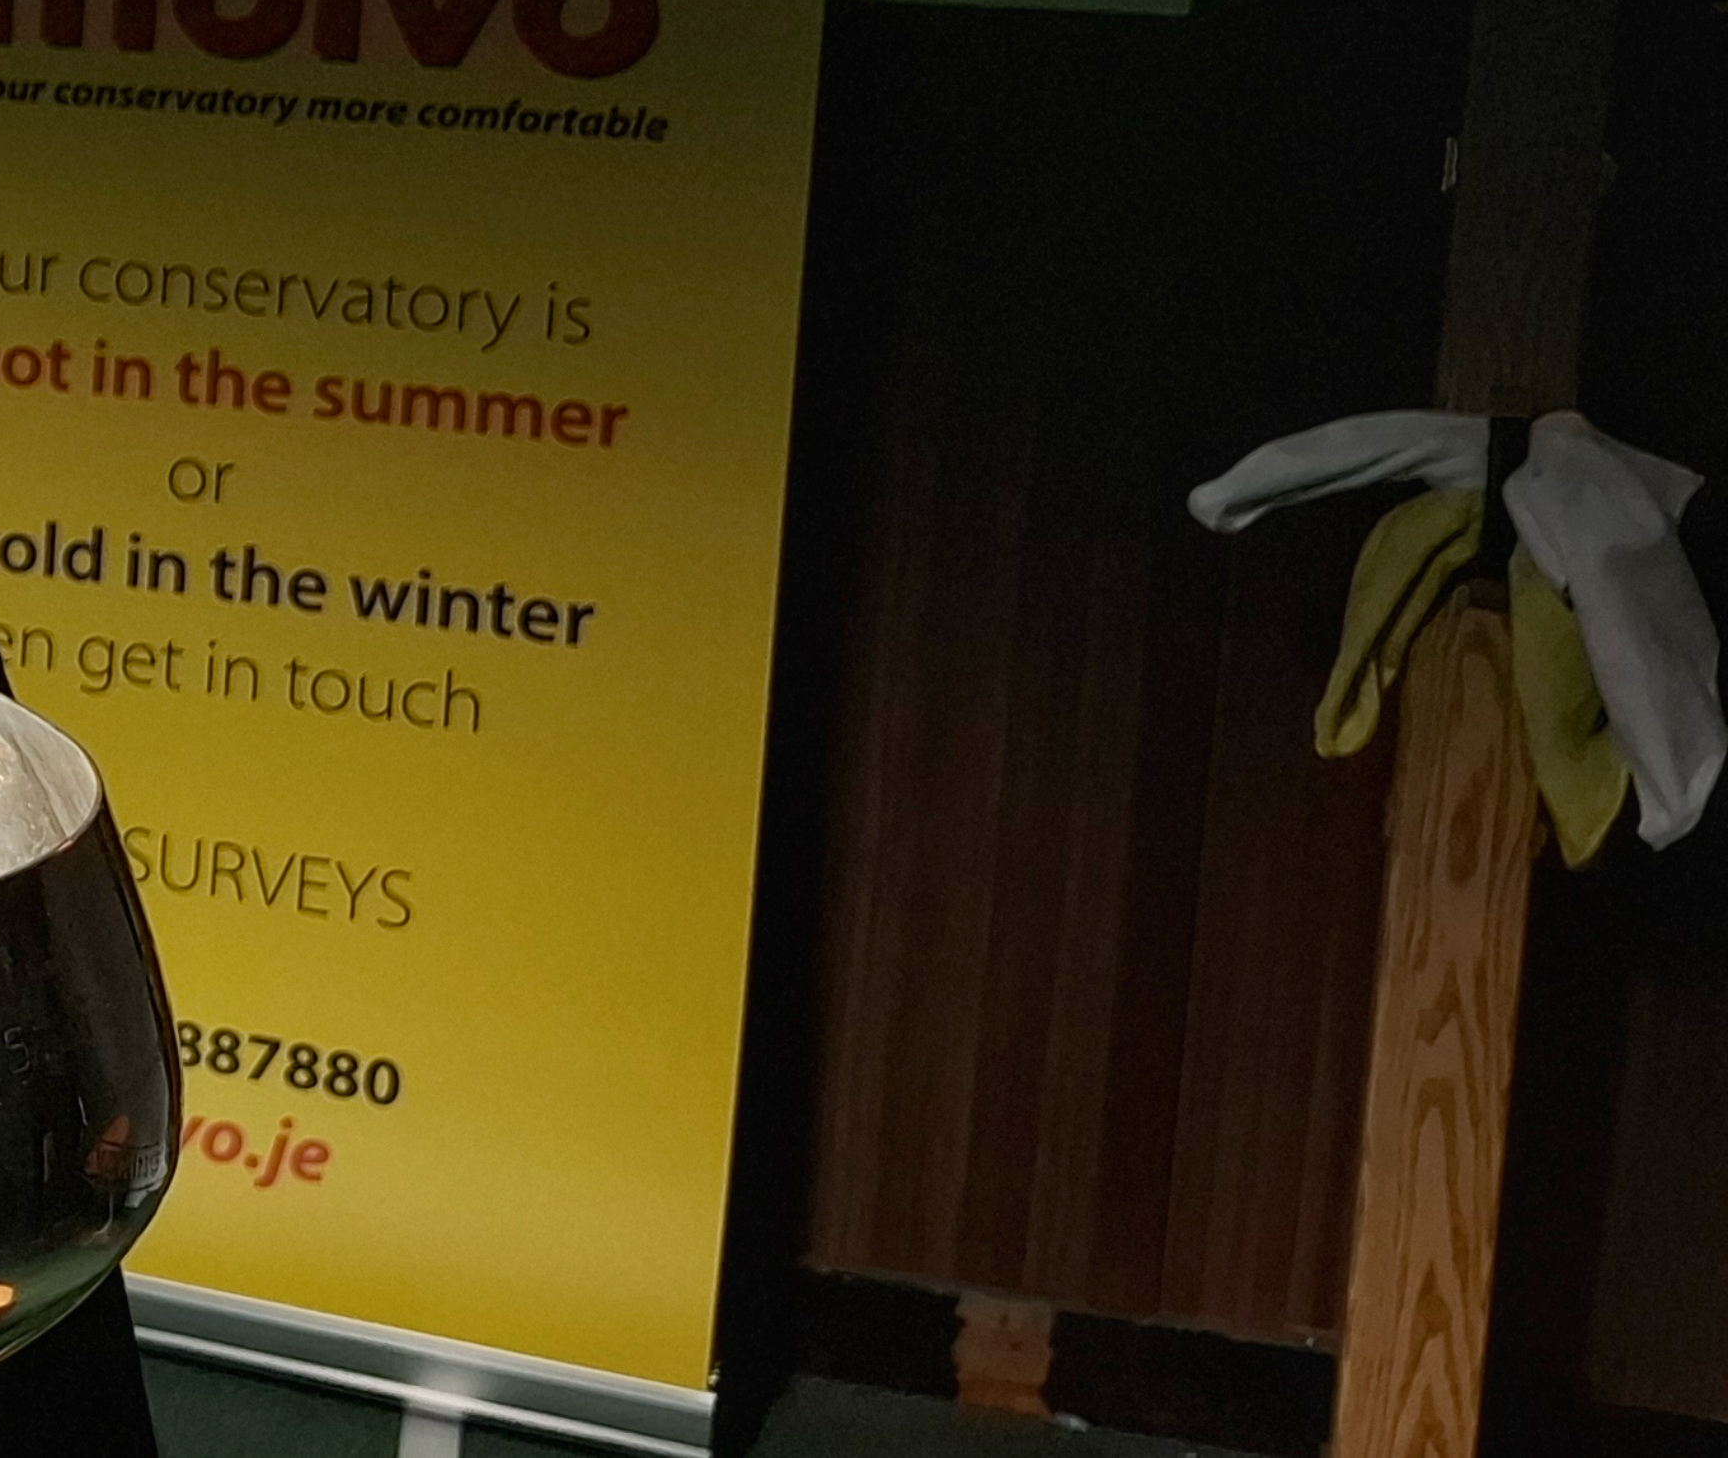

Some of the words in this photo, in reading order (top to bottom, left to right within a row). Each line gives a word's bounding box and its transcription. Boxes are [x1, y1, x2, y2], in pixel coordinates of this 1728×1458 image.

[54, 78, 299, 127] conservatory
[307, 94, 409, 124] more
[417, 98, 669, 142] comfortable
[78, 255, 522, 354] conservatory
[544, 280, 593, 345] is
[93, 338, 153, 400] in
[175, 346, 293, 416] the
[313, 374, 630, 449] summer
[168, 456, 236, 504] or
[126, 531, 186, 595] in
[209, 543, 327, 612] the
[348, 566, 595, 648] winter
[77, 635, 185, 697] get
[205, 639, 259, 703] in
[284, 656, 481, 734] touch
[123, 825, 413, 930] SURVEYS
